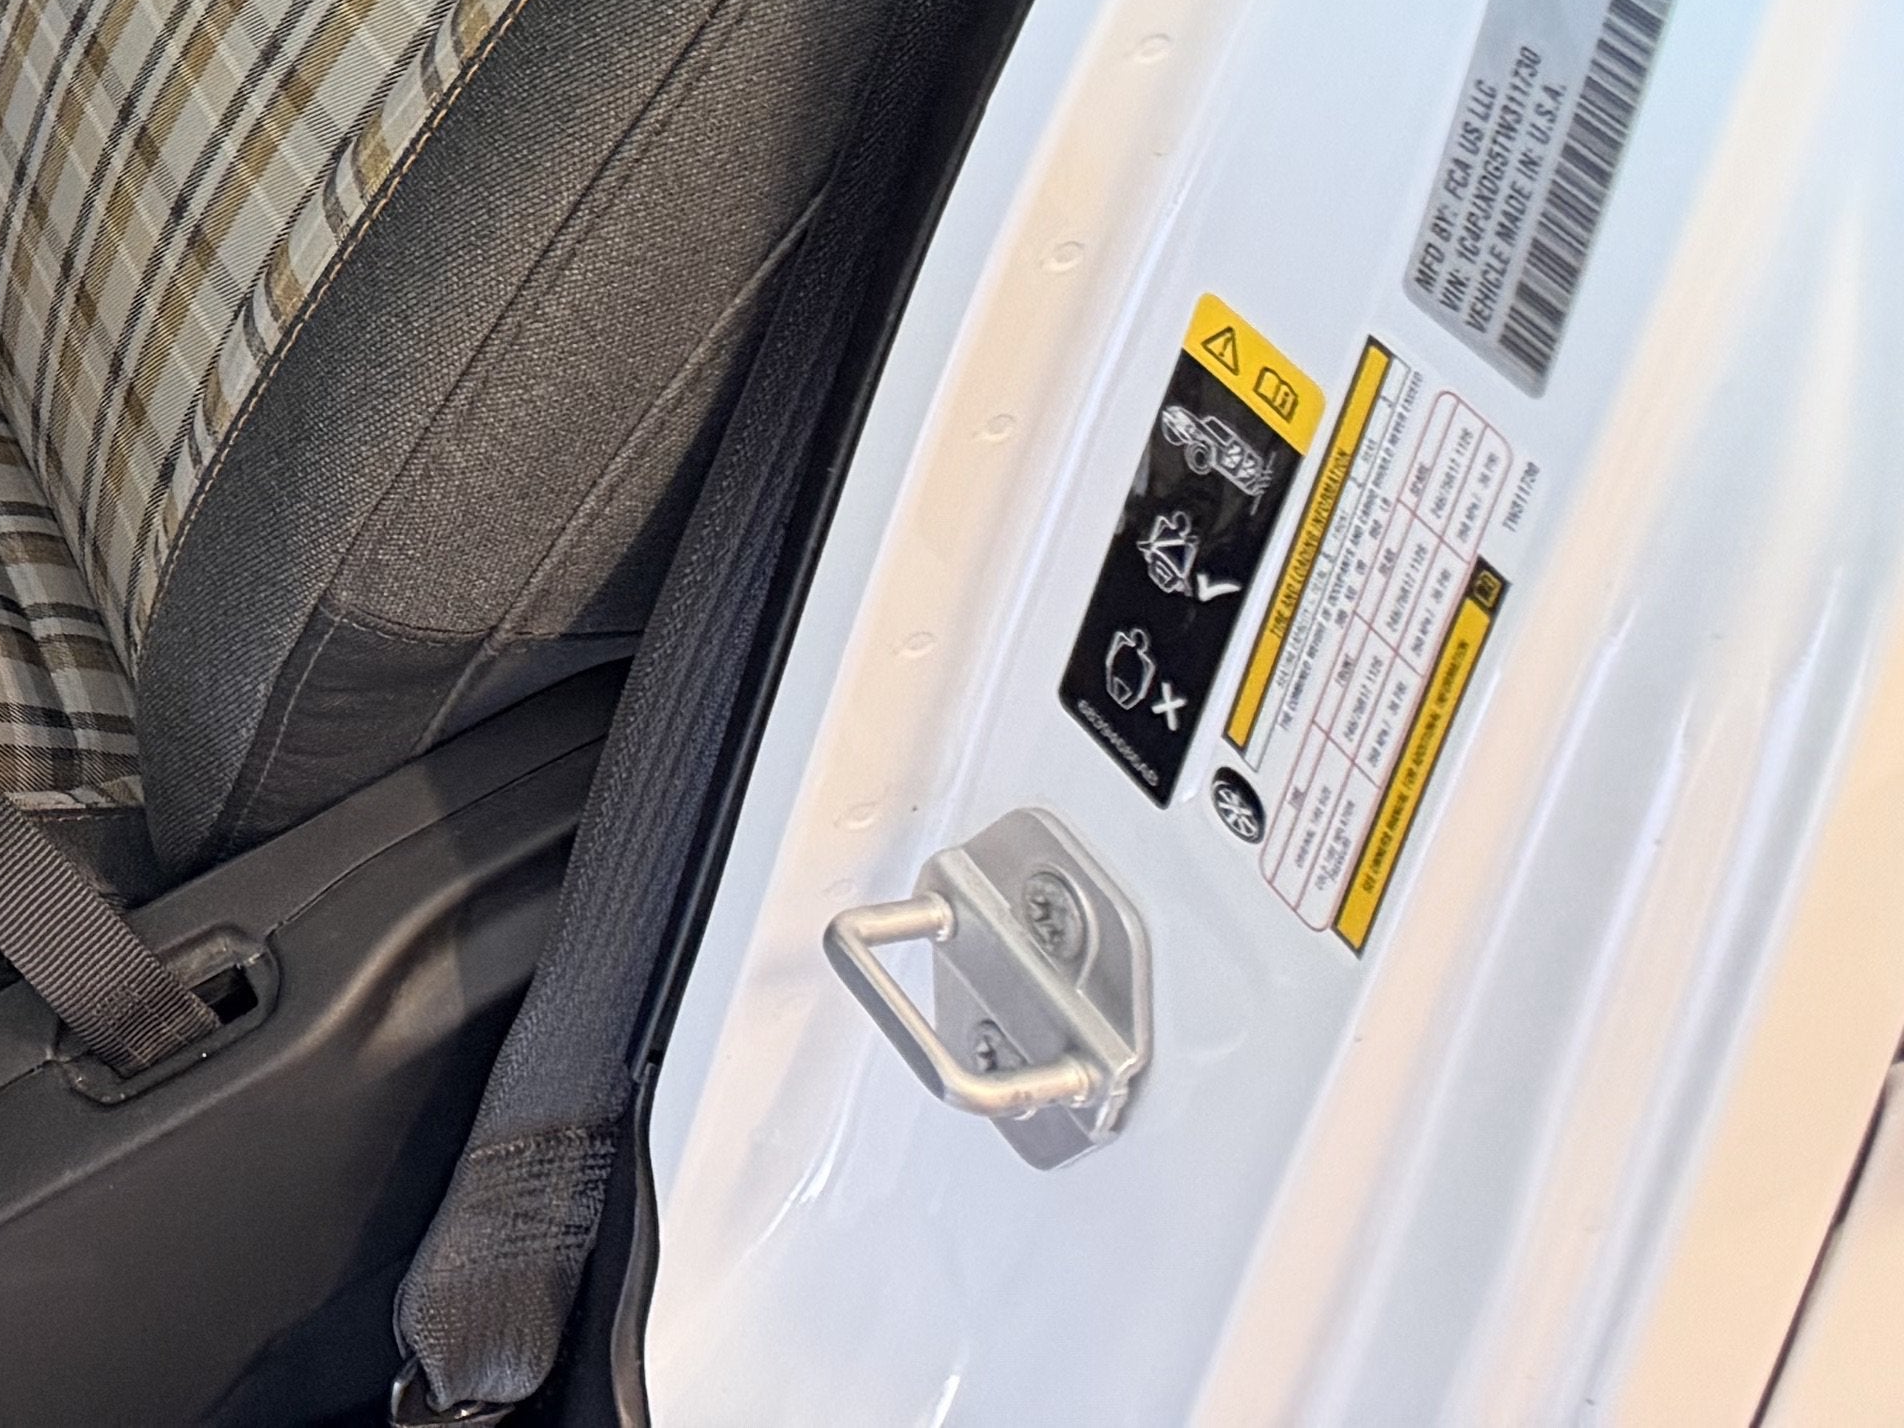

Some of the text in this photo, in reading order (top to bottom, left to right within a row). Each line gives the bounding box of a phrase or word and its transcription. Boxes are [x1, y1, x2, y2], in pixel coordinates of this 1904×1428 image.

[1414, 78, 1497, 293] MFD BY: FCA US LLC
[1466, 84, 1566, 332] VEHICLE MADE IN: U.S.A.
[1439, 269, 1469, 311] VIN:
[1269, 449, 1351, 643] TIRE AND LOADING INFORMATION
